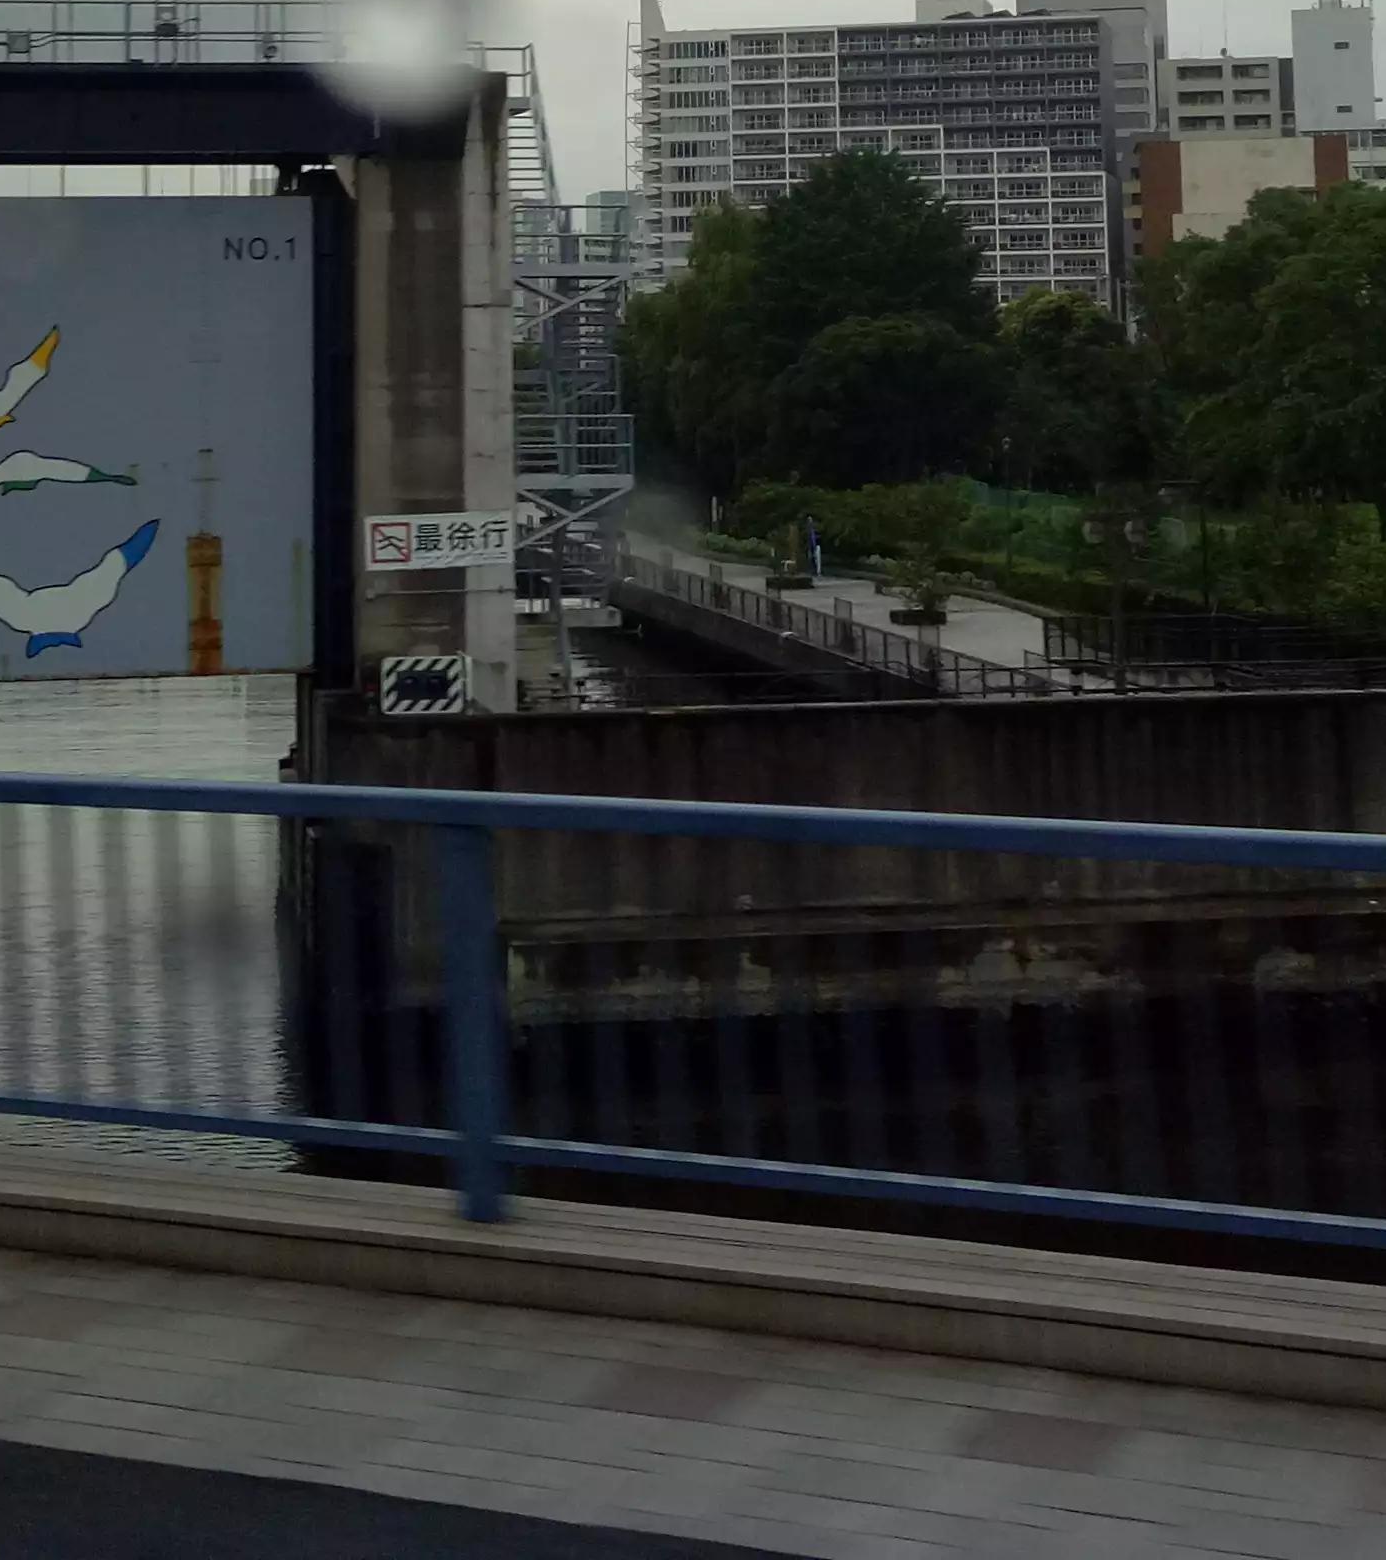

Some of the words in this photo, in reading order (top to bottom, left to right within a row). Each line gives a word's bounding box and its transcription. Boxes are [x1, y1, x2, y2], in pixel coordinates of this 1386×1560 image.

[224, 237, 295, 260] NO.1
[413, 520, 509, 552] 最徐行
